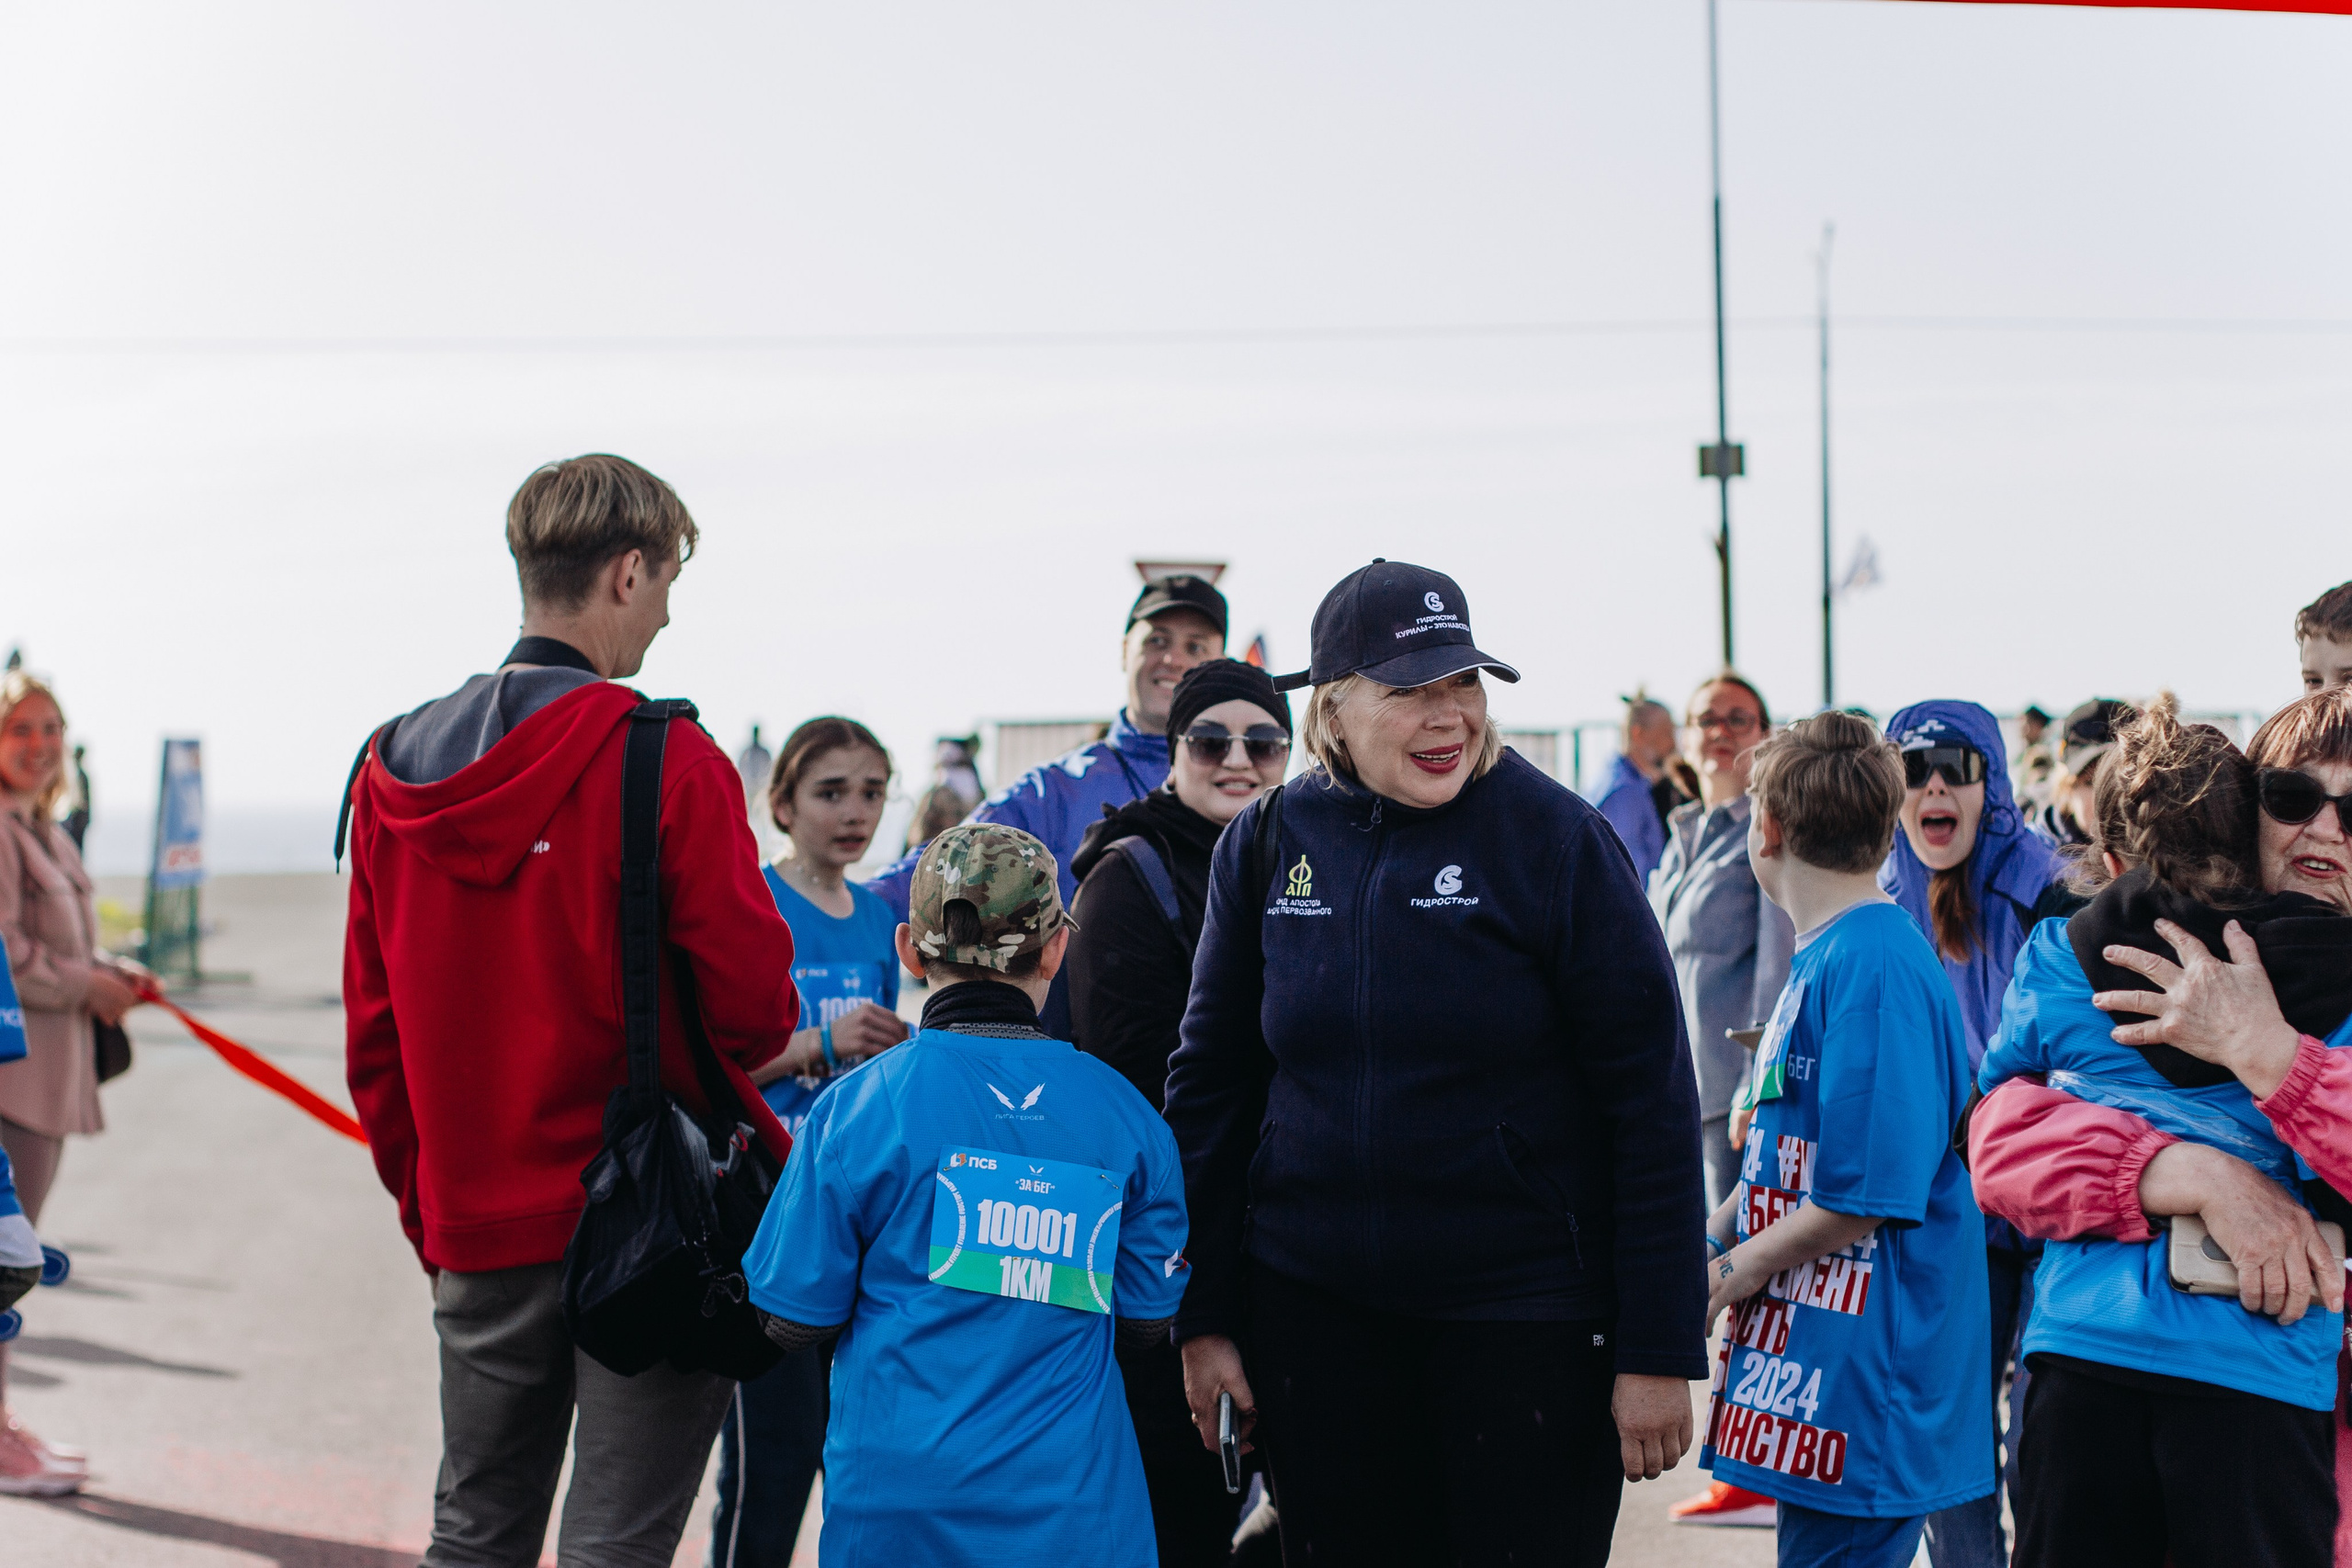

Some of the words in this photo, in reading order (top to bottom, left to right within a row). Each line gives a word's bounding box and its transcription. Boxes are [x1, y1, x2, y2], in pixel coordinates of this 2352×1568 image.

[1416, 615, 1458, 625] ГИДРОСТРОЙ
[1396, 625, 1429, 639] КУРИЛЫ
[1410, 897, 1479, 908] ГИДРОСТРОЙ
[968, 1156, 998, 1170] ПСБ
[977, 1198, 1078, 1258] 10001
[1733, 1351, 1823, 1422] 2024
